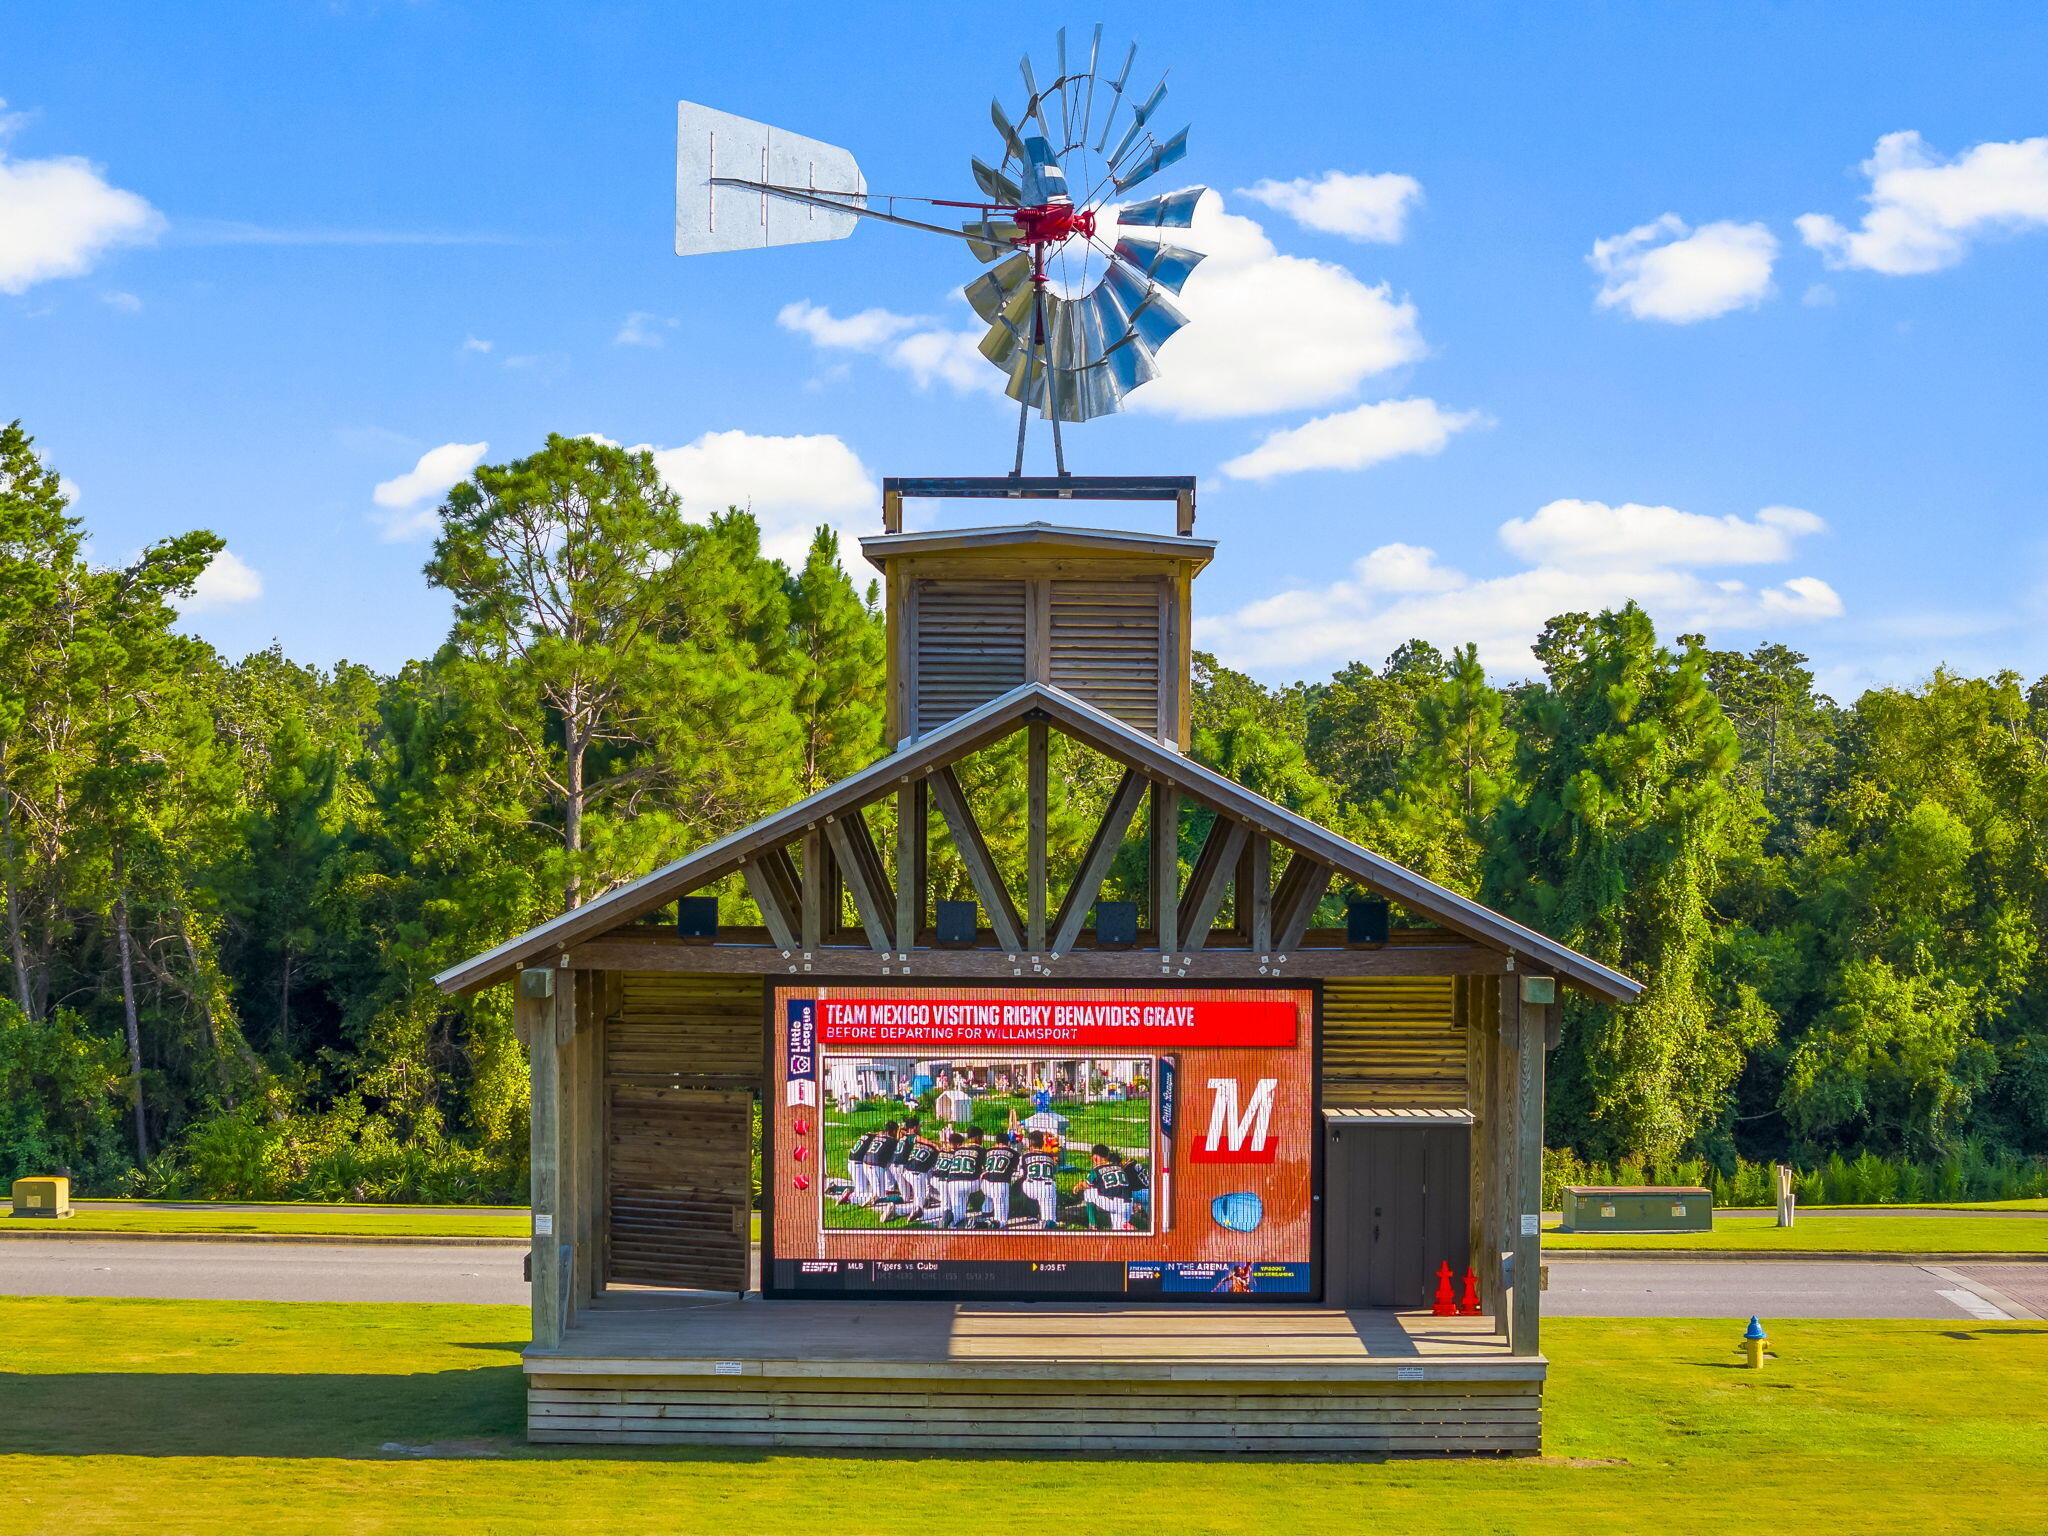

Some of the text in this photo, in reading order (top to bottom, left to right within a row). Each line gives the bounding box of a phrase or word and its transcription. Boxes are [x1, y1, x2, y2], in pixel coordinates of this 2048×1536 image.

[826, 1004, 1195, 1027] TEAM MEXICO VISITING RICKY BENAVIDES GRAVE
[801, 1006, 813, 1052] League
[826, 1027, 877, 1038] BEFORE
[880, 1027, 953, 1039] DEPARTING
[957, 1028, 981, 1039] FOR
[1204, 1078, 1278, 1151] M
[802, 1262, 838, 1272] ESPN
[847, 1262, 864, 1270] MLB
[876, 1262, 901, 1271] Tigers
[916, 1262, 938, 1270] Cubs
[1176, 1262, 1195, 1271] THE
[1196, 1262, 1229, 1271] ARENA
